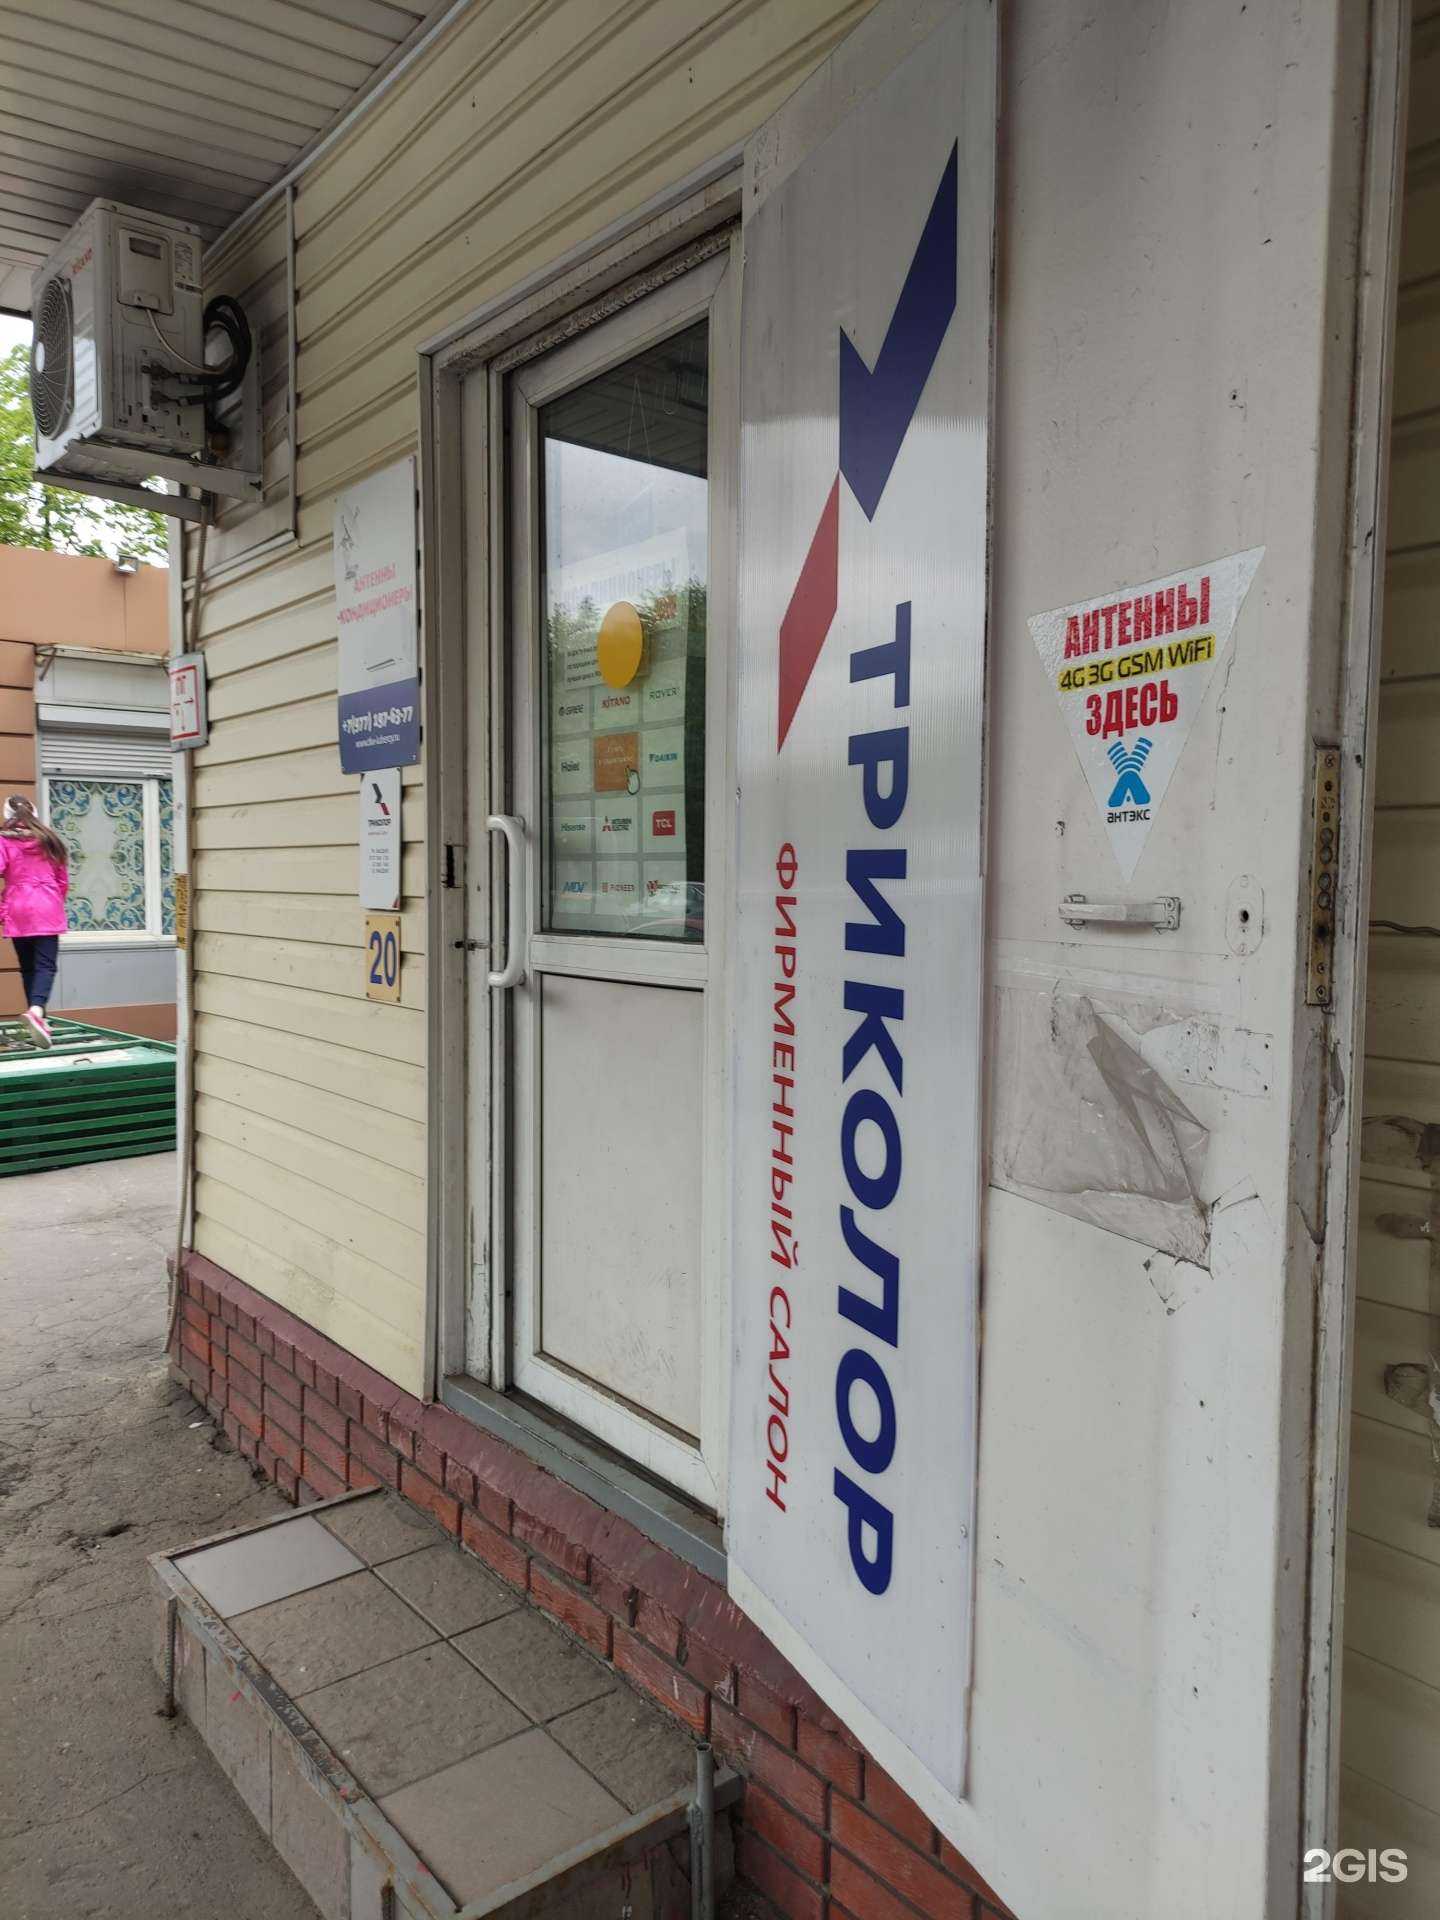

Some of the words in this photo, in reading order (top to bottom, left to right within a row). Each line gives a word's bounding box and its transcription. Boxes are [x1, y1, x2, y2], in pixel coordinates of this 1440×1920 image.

[1064, 577, 1210, 659] АНТЕННЫ
[1060, 667, 1085, 690] 4G
[1089, 662, 1113, 685] 3G
[1118, 648, 1163, 679] GSM
[1168, 637, 1212, 666] WiFi
[1086, 680, 1178, 740] ЗДЕСЬ
[369, 931, 397, 987] 20
[768, 842, 801, 1269] ФИРМЕННЫЙ
[833, 601, 912, 1596] ТРИКОЛОР
[765, 1284, 795, 1513] САЛОН
